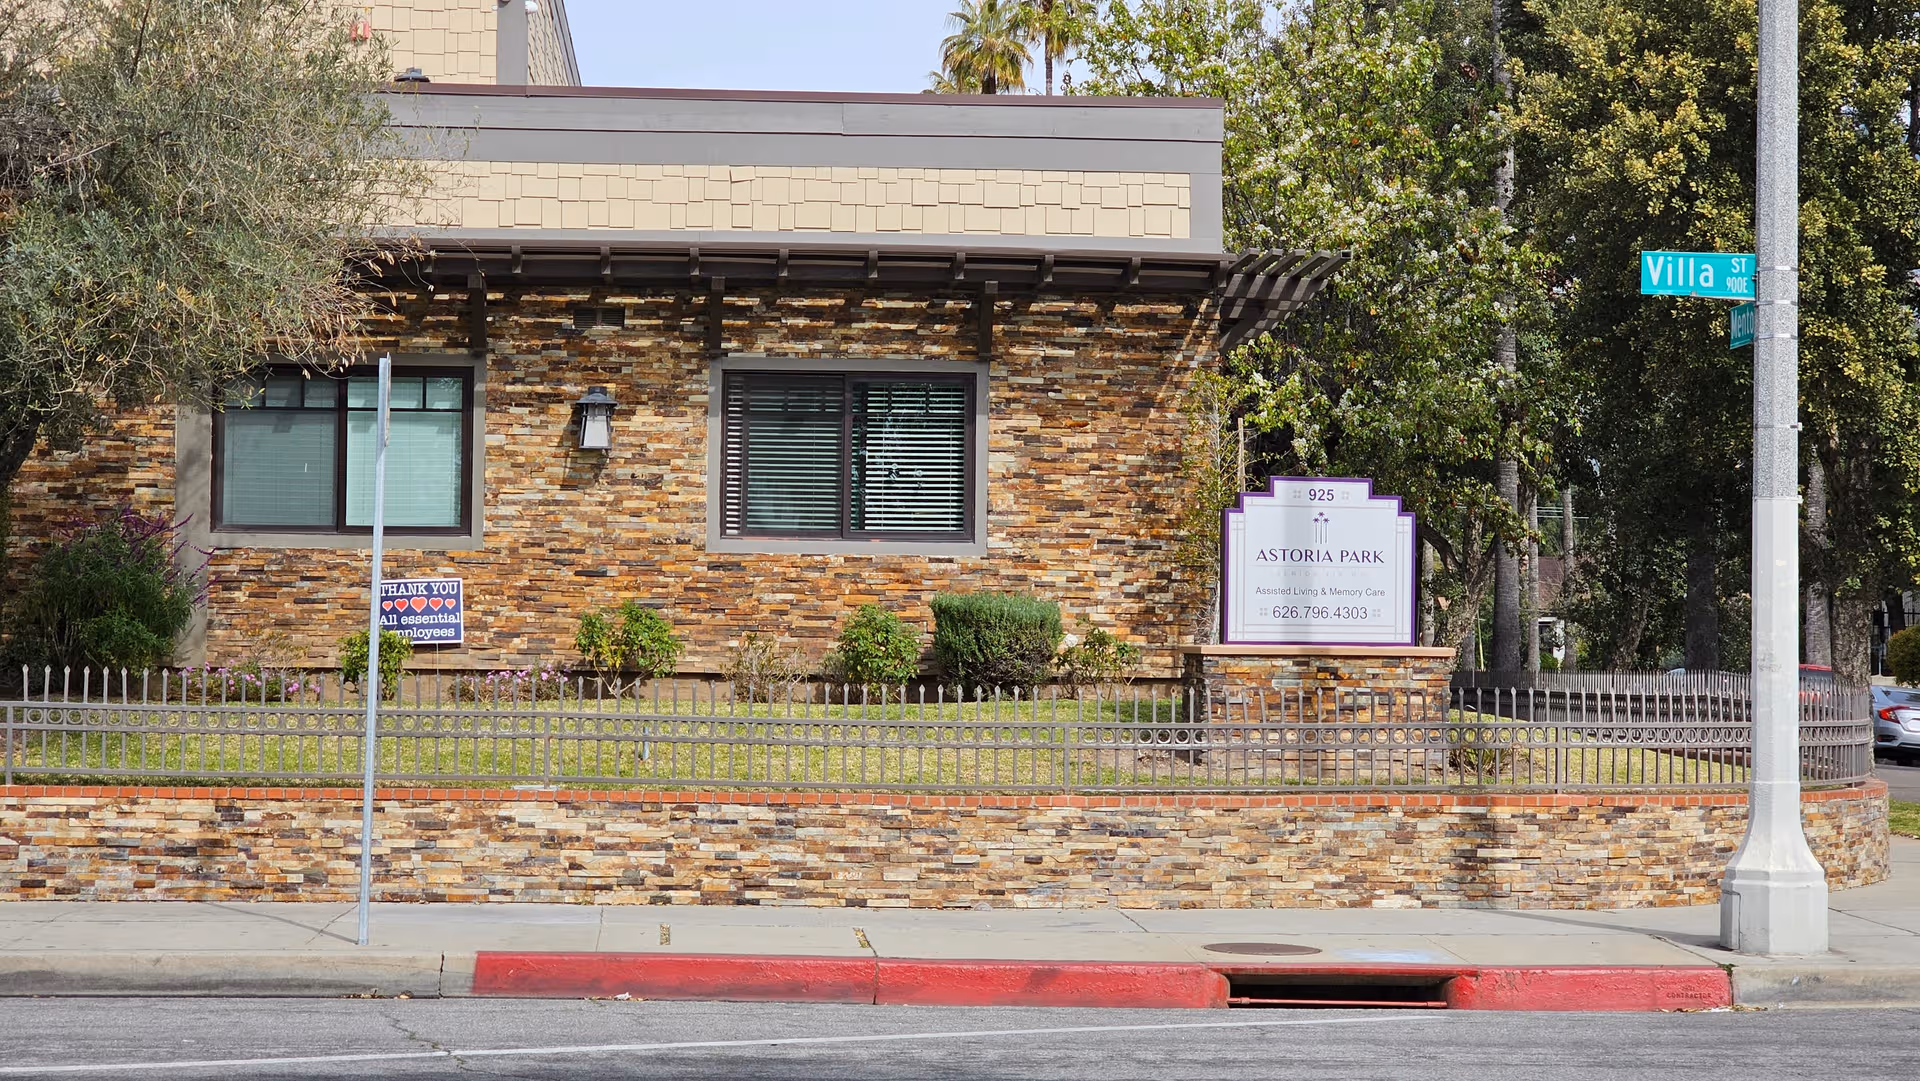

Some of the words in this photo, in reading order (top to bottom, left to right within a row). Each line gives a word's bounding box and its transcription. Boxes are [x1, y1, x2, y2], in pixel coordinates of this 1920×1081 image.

[1646, 255, 1714, 288] Villa
[1731, 257, 1748, 274] ST
[1726, 276, 1748, 293] 900E
[1731, 306, 1755, 340] Mento
[1308, 488, 1335, 501] 925
[1256, 548, 1333, 563] ASTORIA
[1340, 549, 1385, 564] PARK
[381, 583, 428, 596] THANK
[430, 582, 458, 595] YOU
[1255, 587, 1291, 596] Assisted
[1293, 587, 1319, 598] Living
[1320, 588, 1327, 596] &
[1329, 588, 1363, 599] Memory
[1365, 588, 1386, 597] Care
[379, 615, 398, 625] All
[401, 613, 460, 625] essential
[1272, 605, 1368, 620] 626.796.4303
[397, 627, 455, 639] mployees
